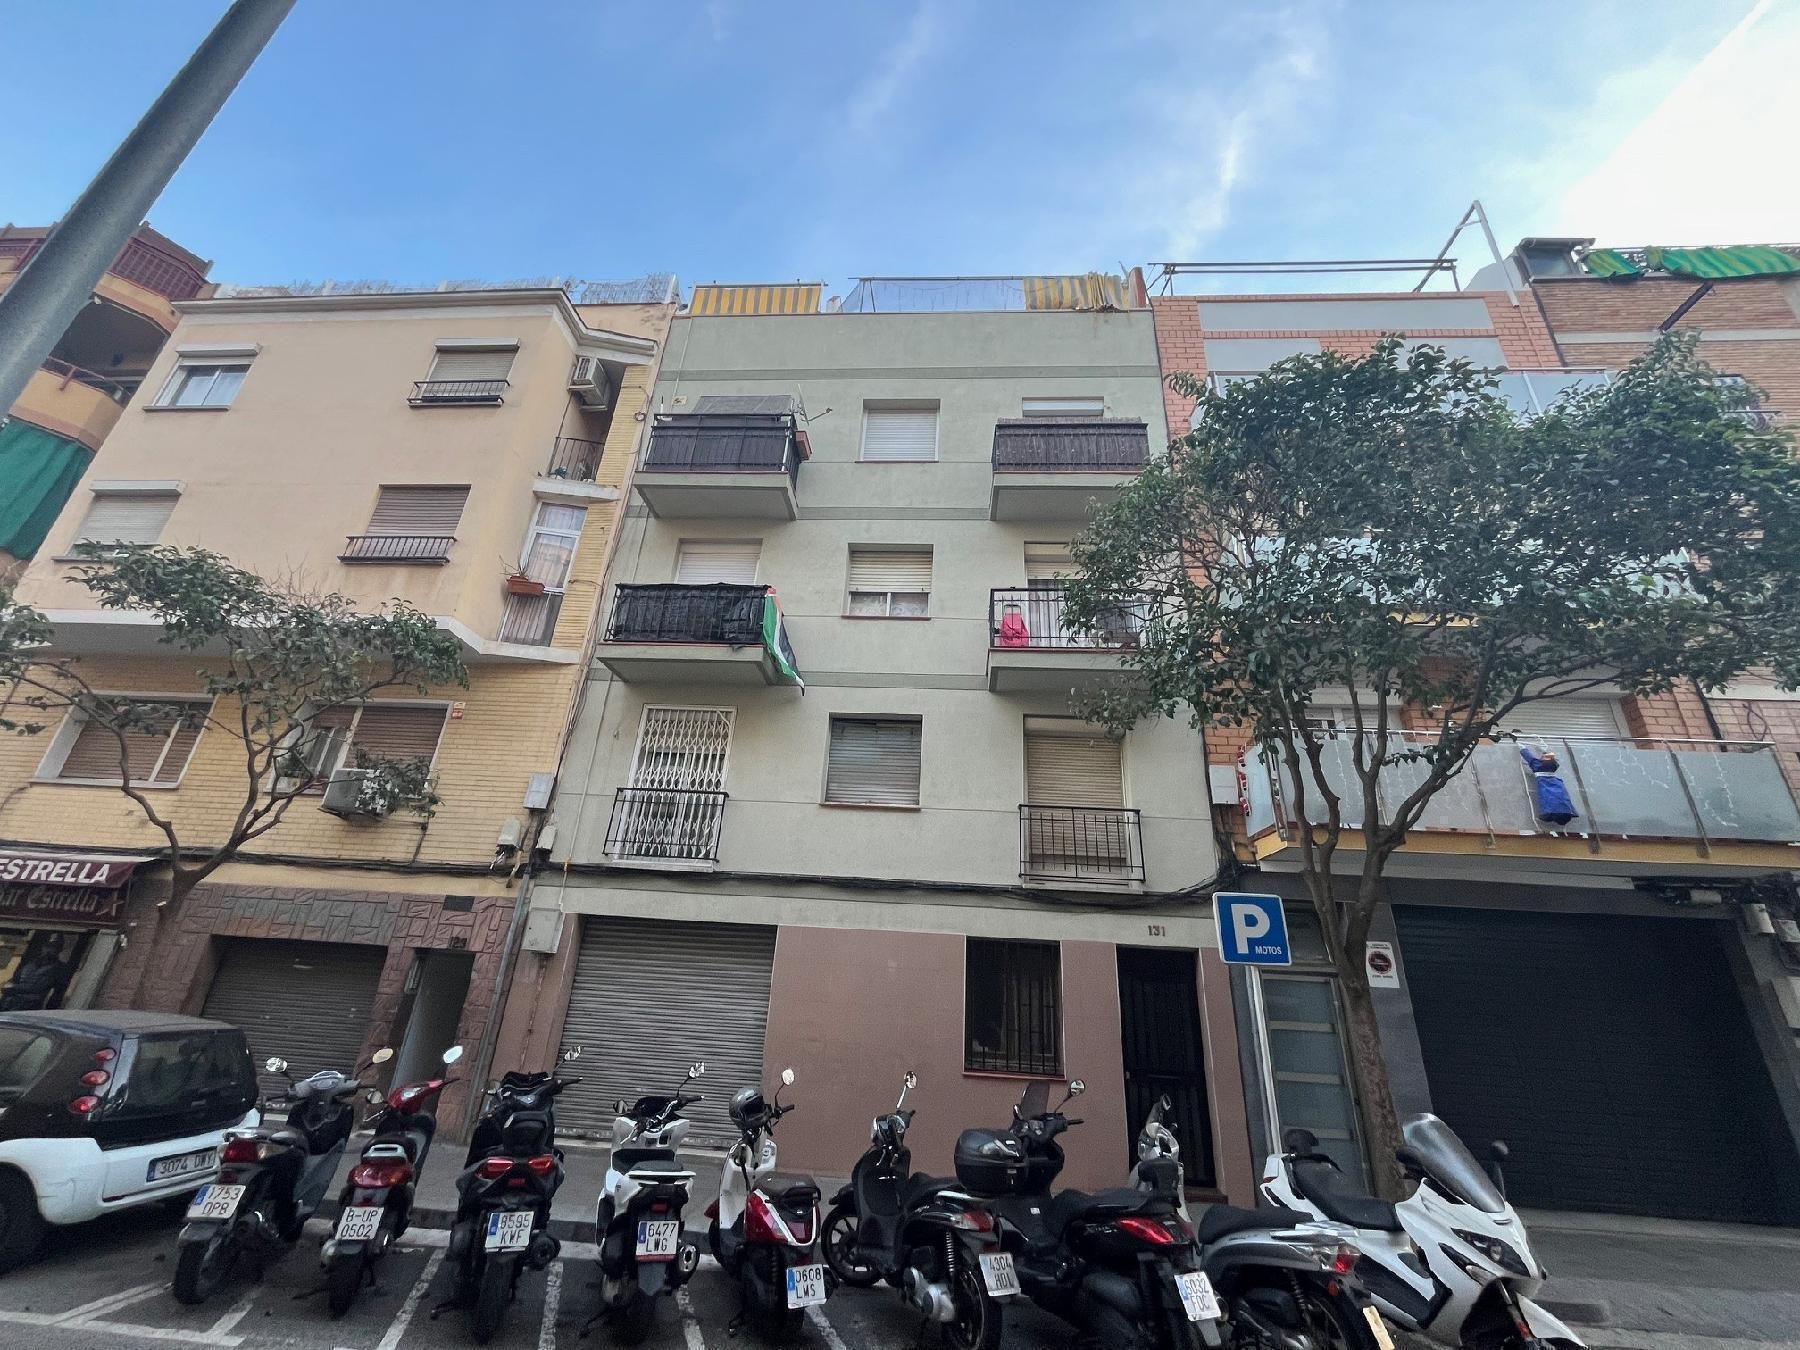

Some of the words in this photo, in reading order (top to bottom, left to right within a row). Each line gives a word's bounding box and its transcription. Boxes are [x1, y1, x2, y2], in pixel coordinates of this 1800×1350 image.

[1148, 925, 1166, 937] 131
[1231, 904, 1270, 954] P
[1255, 945, 1282, 955] MOTOS
[159, 1158, 188, 1174] 3074
[208, 1186, 241, 1200] 1753
[346, 1208, 378, 1222] B-UP
[500, 1213, 530, 1229] 8595
[341, 1224, 373, 1238] 0502
[648, 1223, 676, 1237] 6477
[646, 1238, 667, 1252] LWG
[989, 1255, 1012, 1271] 4304
[796, 1267, 821, 1283] 0608
[796, 1284, 816, 1299] LMS
[1184, 1278, 1210, 1295] 6032
